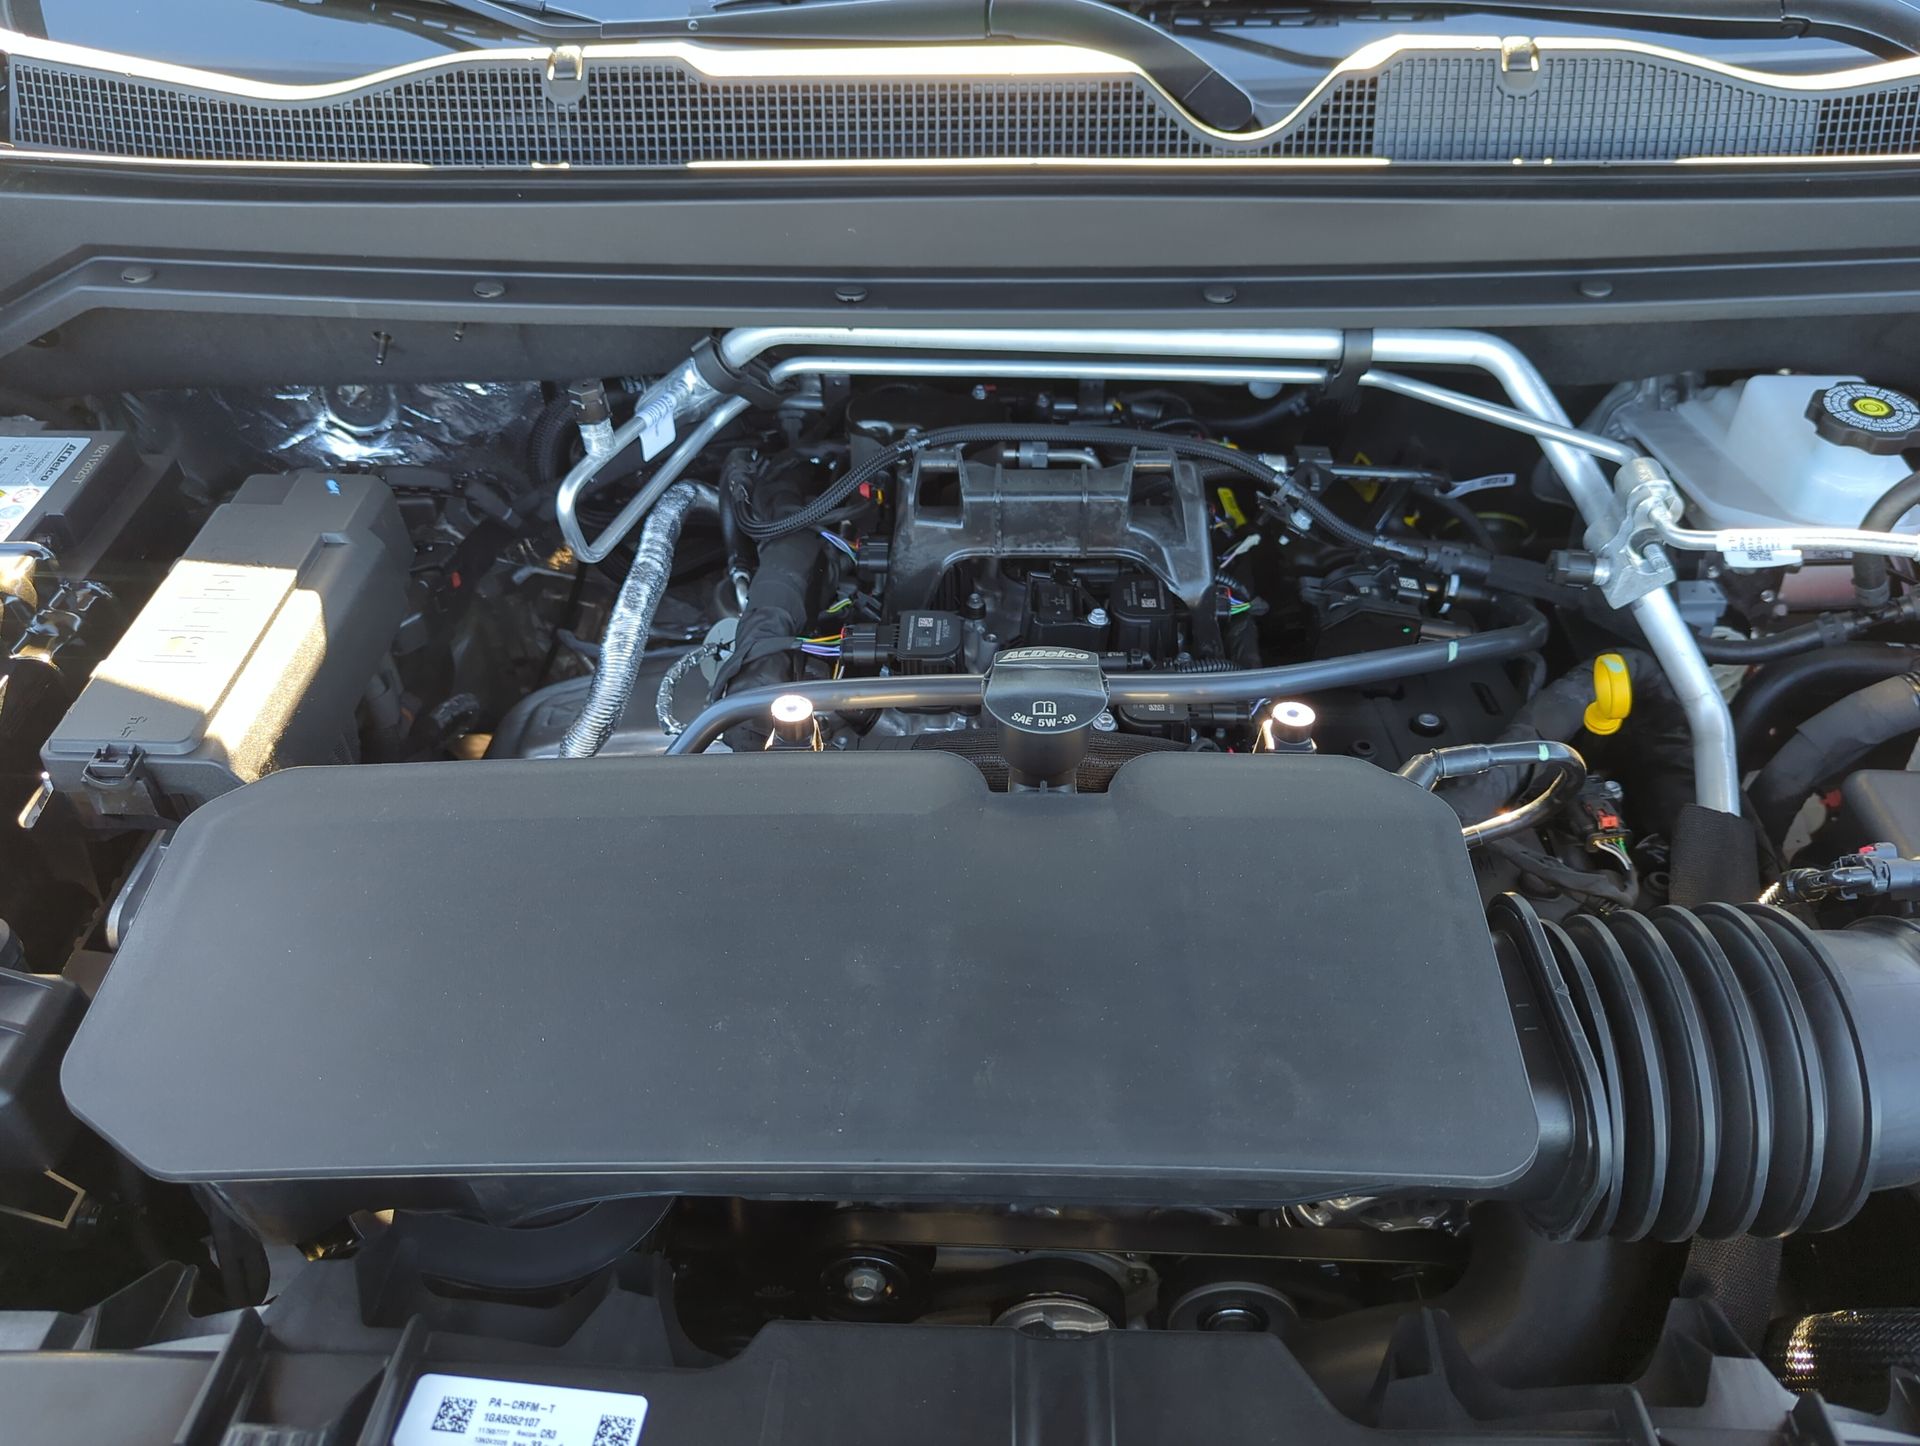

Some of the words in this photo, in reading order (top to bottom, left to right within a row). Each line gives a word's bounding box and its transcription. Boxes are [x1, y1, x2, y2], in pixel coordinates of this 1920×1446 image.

[40, 443, 77, 481] ACDelco
[1001, 650, 1090, 661] ACDelco
[1011, 712, 1033, 726] SAE
[1038, 714, 1077, 727] 5W-30
